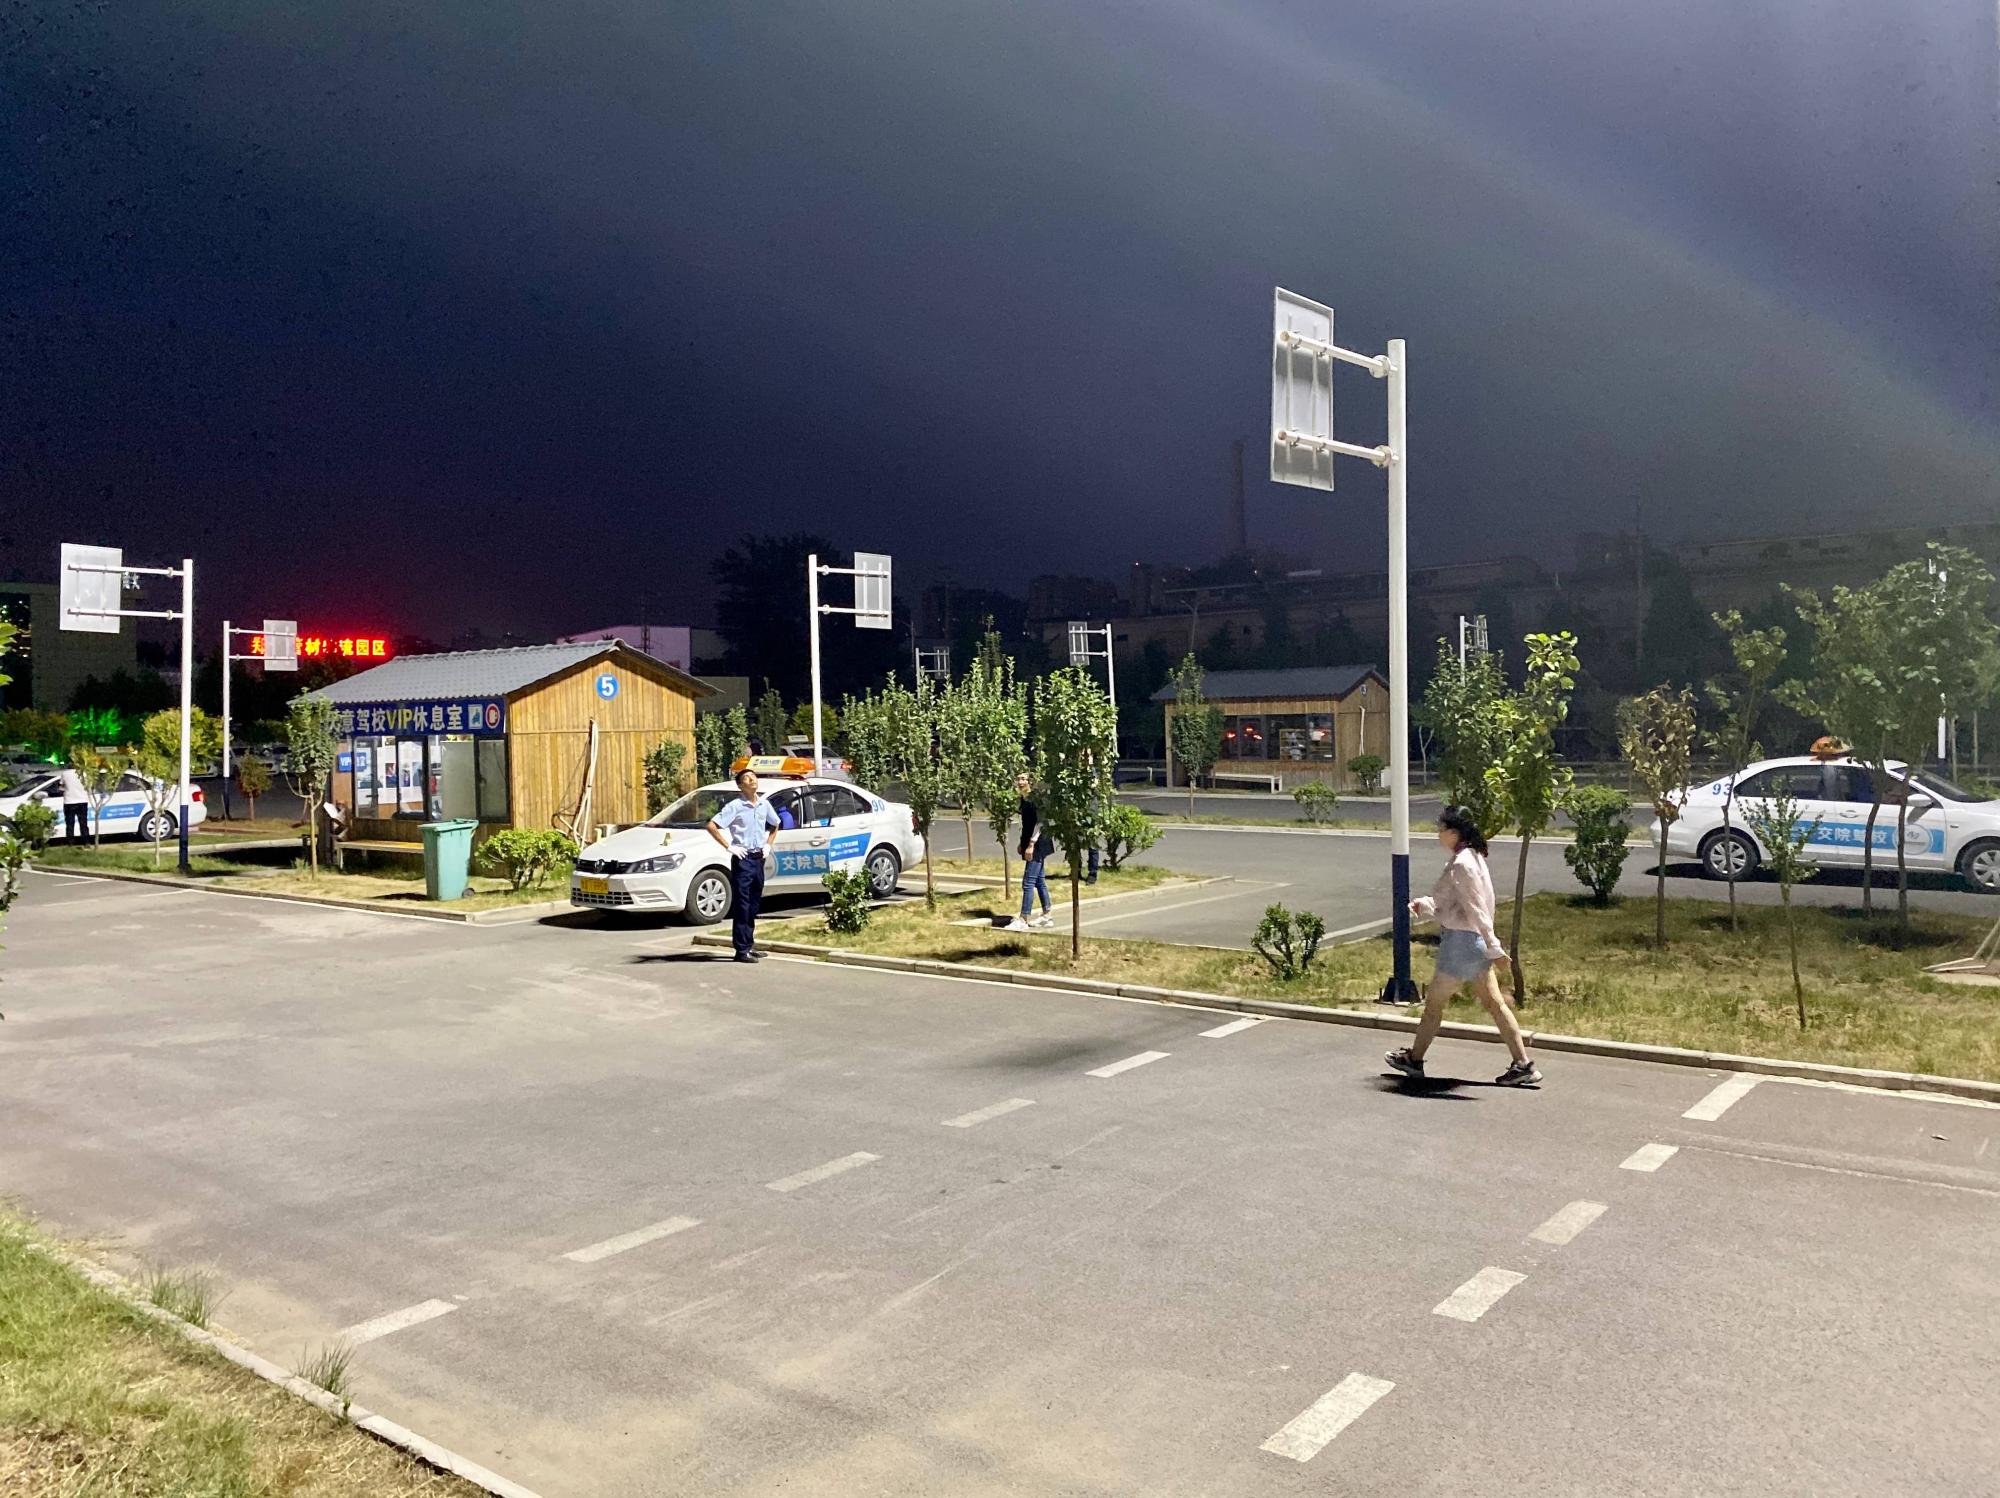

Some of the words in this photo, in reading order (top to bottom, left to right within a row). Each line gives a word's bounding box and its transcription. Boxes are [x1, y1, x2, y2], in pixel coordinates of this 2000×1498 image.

[602, 676, 614, 696] 5
[1712, 783, 1731, 796] 93
[871, 799, 885, 812] 90
